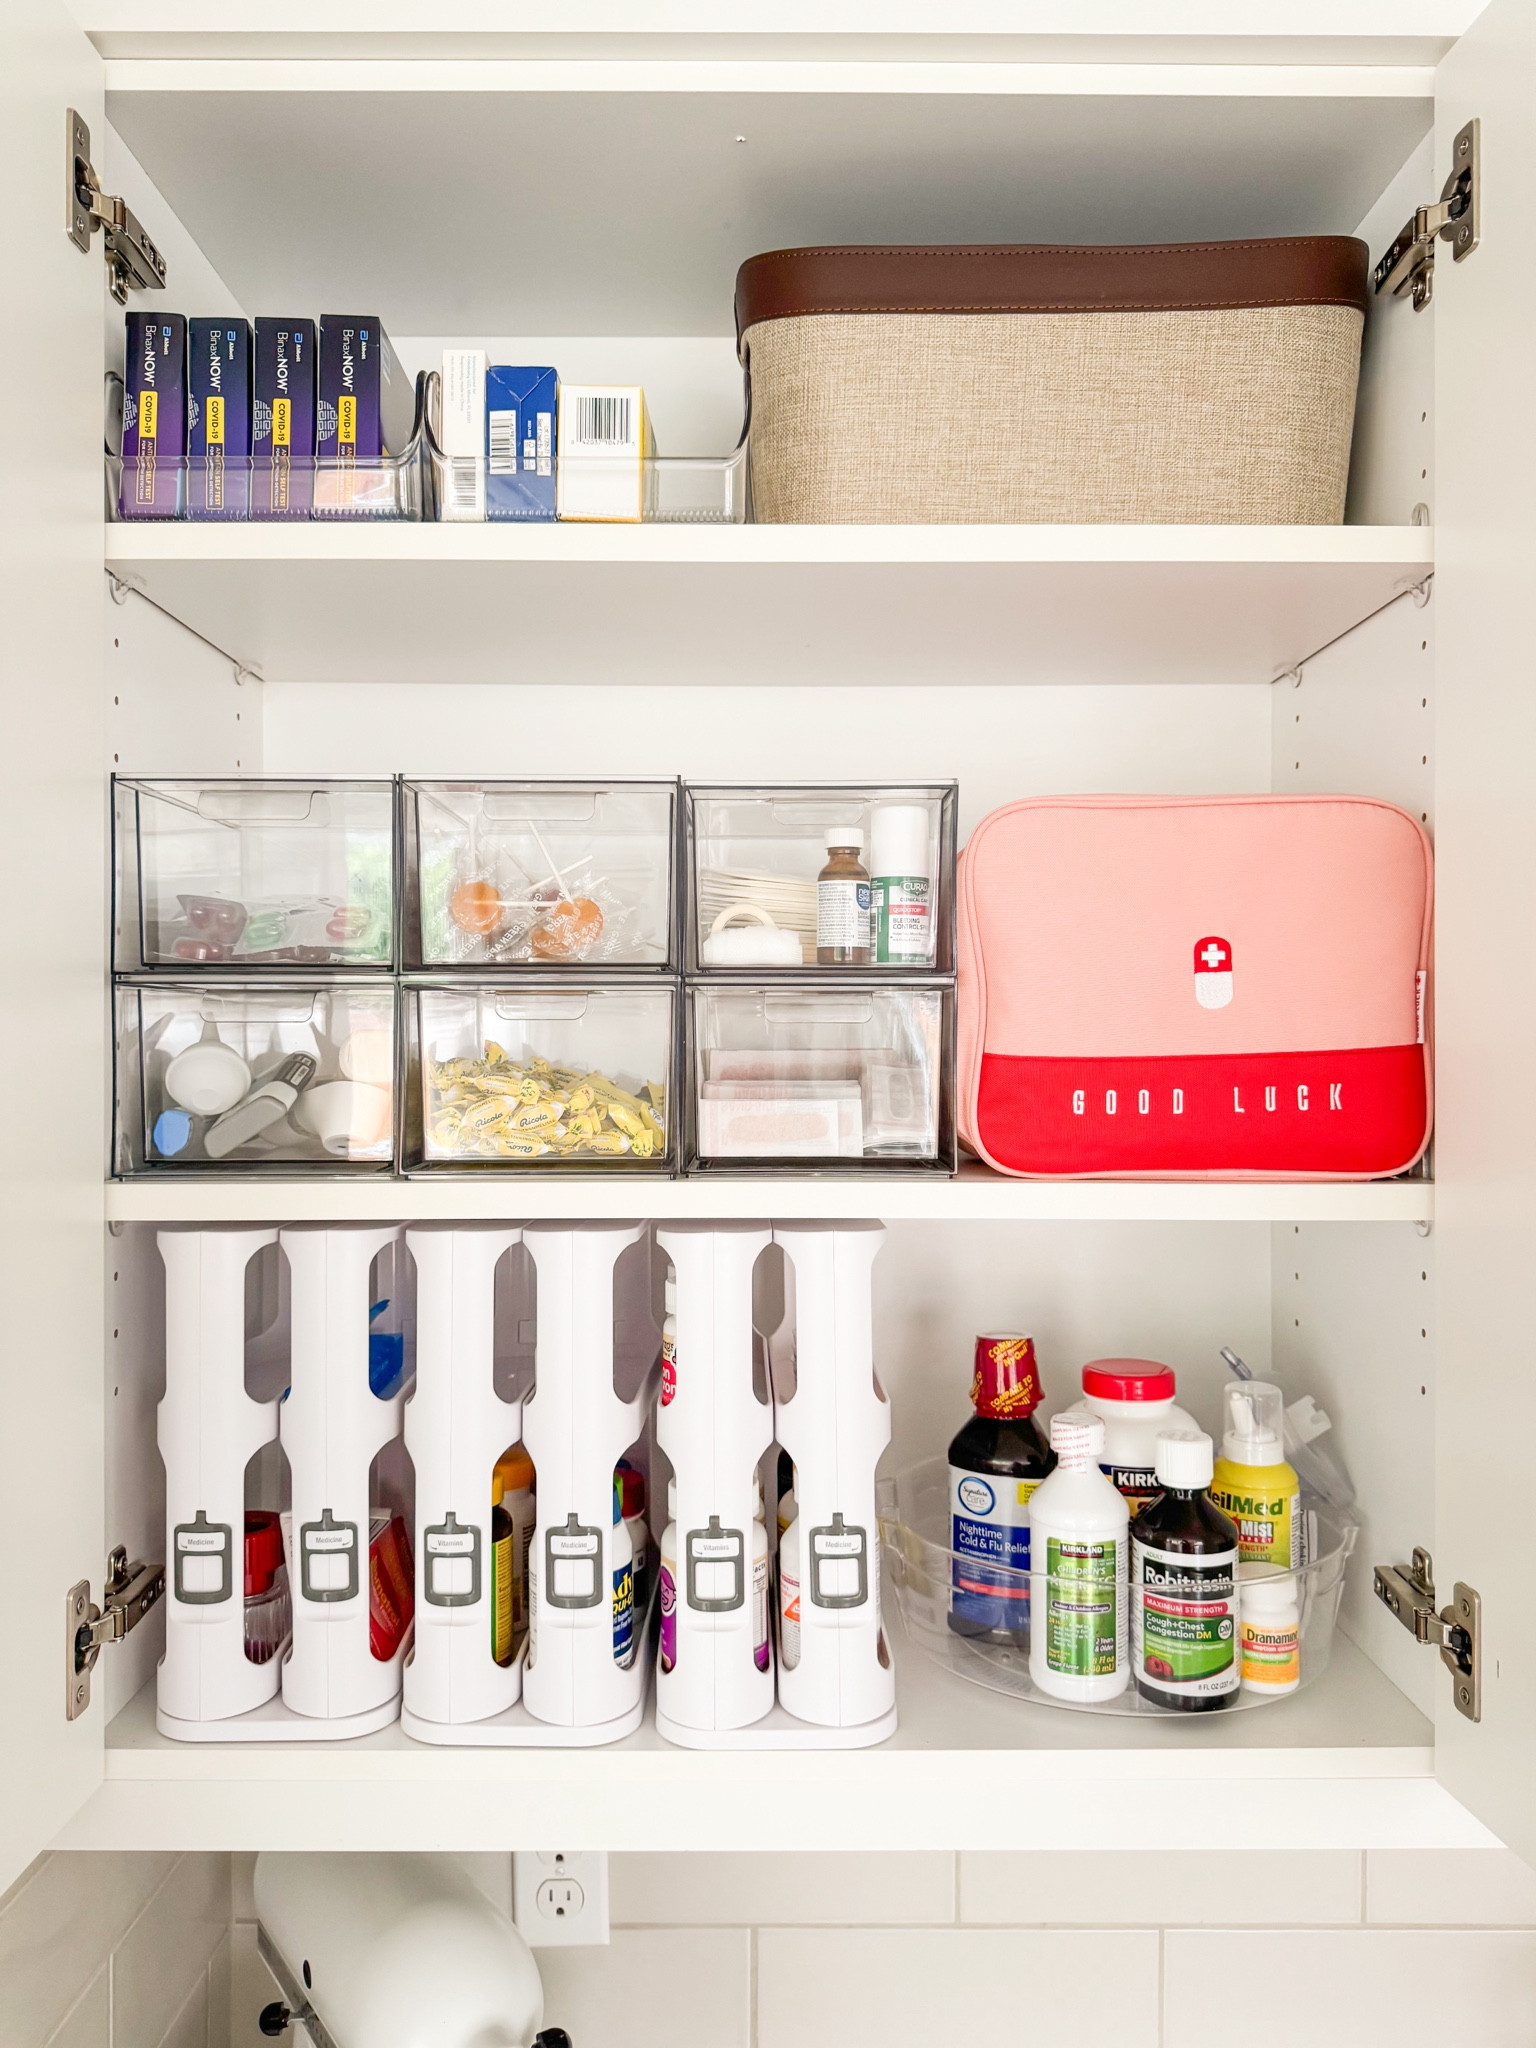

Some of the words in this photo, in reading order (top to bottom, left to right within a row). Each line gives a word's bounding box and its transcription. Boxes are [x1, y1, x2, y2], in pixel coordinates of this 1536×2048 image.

[1073, 1089, 1183, 1114] GOOD
[1234, 1083, 1342, 1113] LUCK
[475, 1112, 503, 1128] Ricola
[520, 1114, 548, 1127] Ricola
[990, 1382, 1024, 1407] COMPARE
[1023, 1374, 1032, 1386] TO
[1118, 1472, 1159, 1487] KIRK
[959, 1521, 1002, 1539] Nighttime
[959, 1533, 978, 1546] Cold
[979, 1538, 987, 1549] &
[989, 1540, 1002, 1551] Flu
[1005, 1542, 1030, 1553] Relief
[1062, 1545, 1103, 1553] KIRKLAND
[1147, 1598, 1182, 1613] MAXIMUM
[1146, 1613, 1204, 1630] Cough+Chest
[1220, 1624, 1231, 1633] DM
[1146, 1622, 1194, 1639] Congestion
